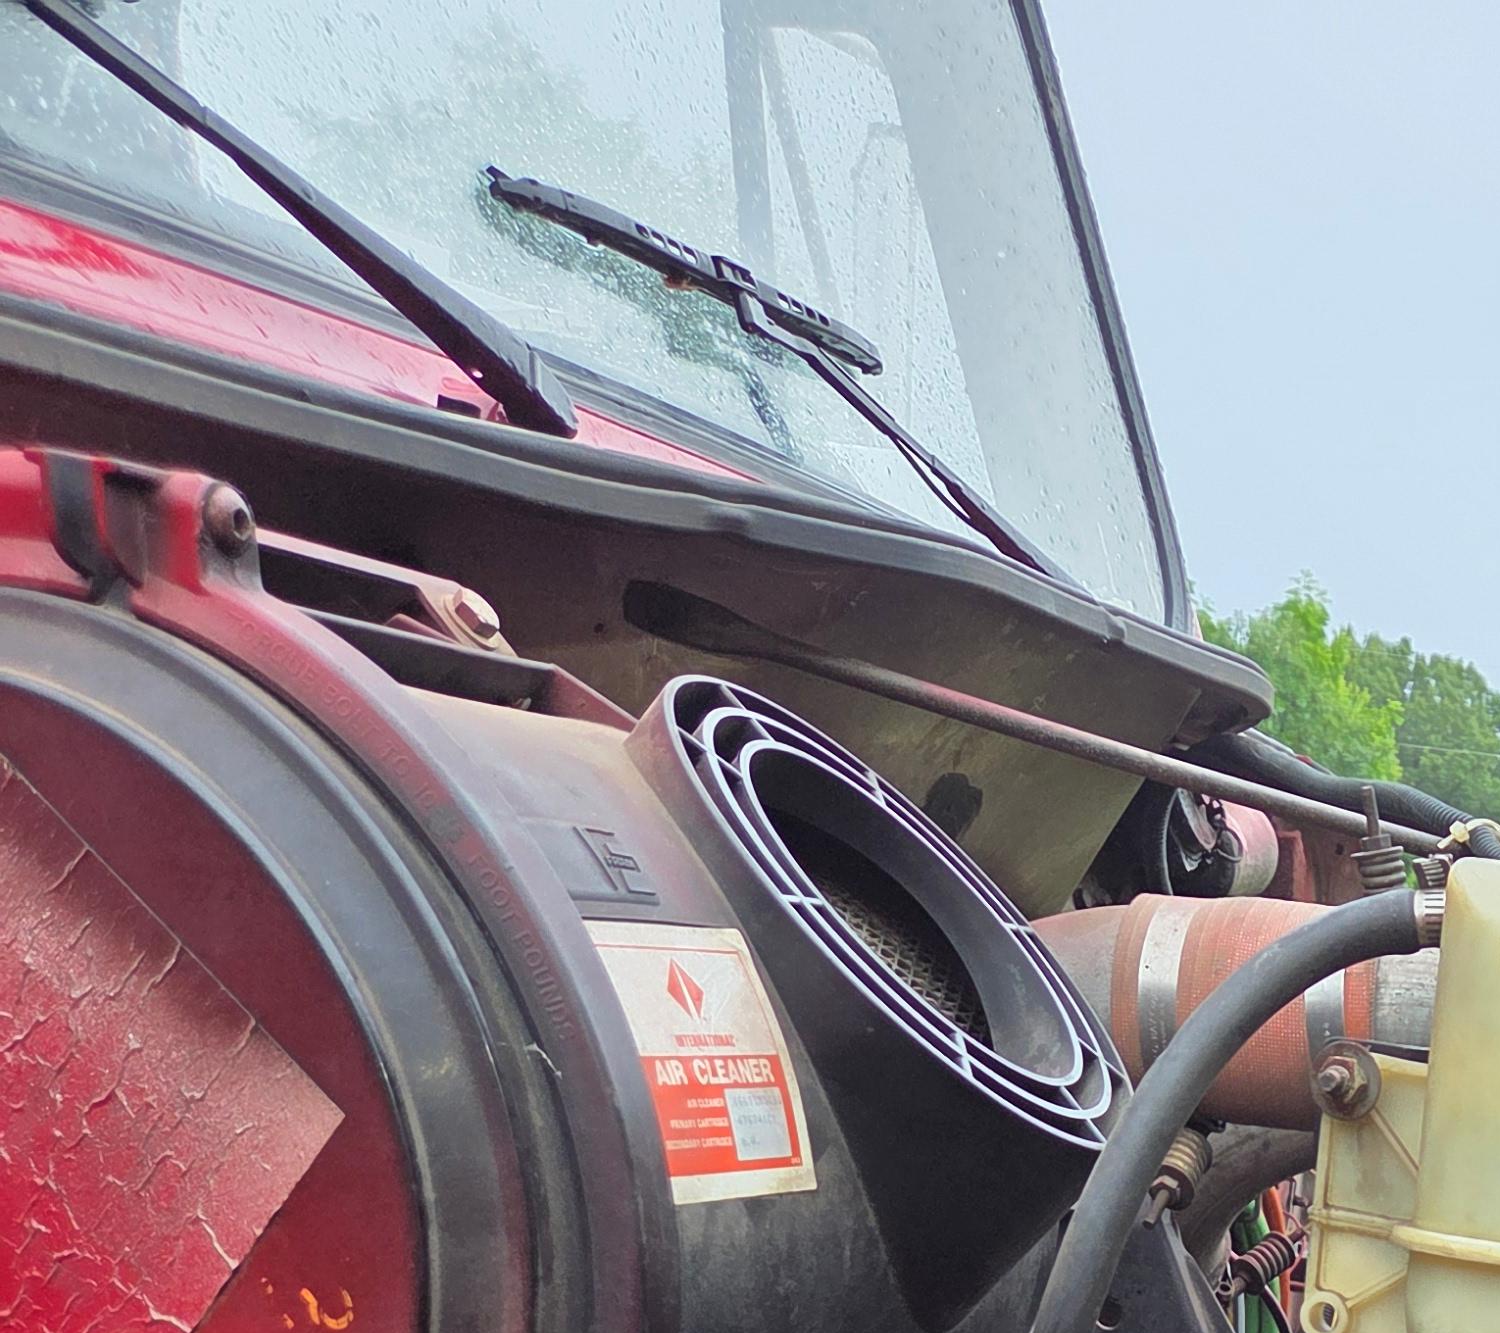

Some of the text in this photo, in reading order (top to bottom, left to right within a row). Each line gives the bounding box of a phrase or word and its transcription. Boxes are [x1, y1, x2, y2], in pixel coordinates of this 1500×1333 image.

[467, 852, 521, 924] FOOT
[513, 929, 577, 1042] POUNDS
[655, 1058, 775, 1086] AIR CLEANER
